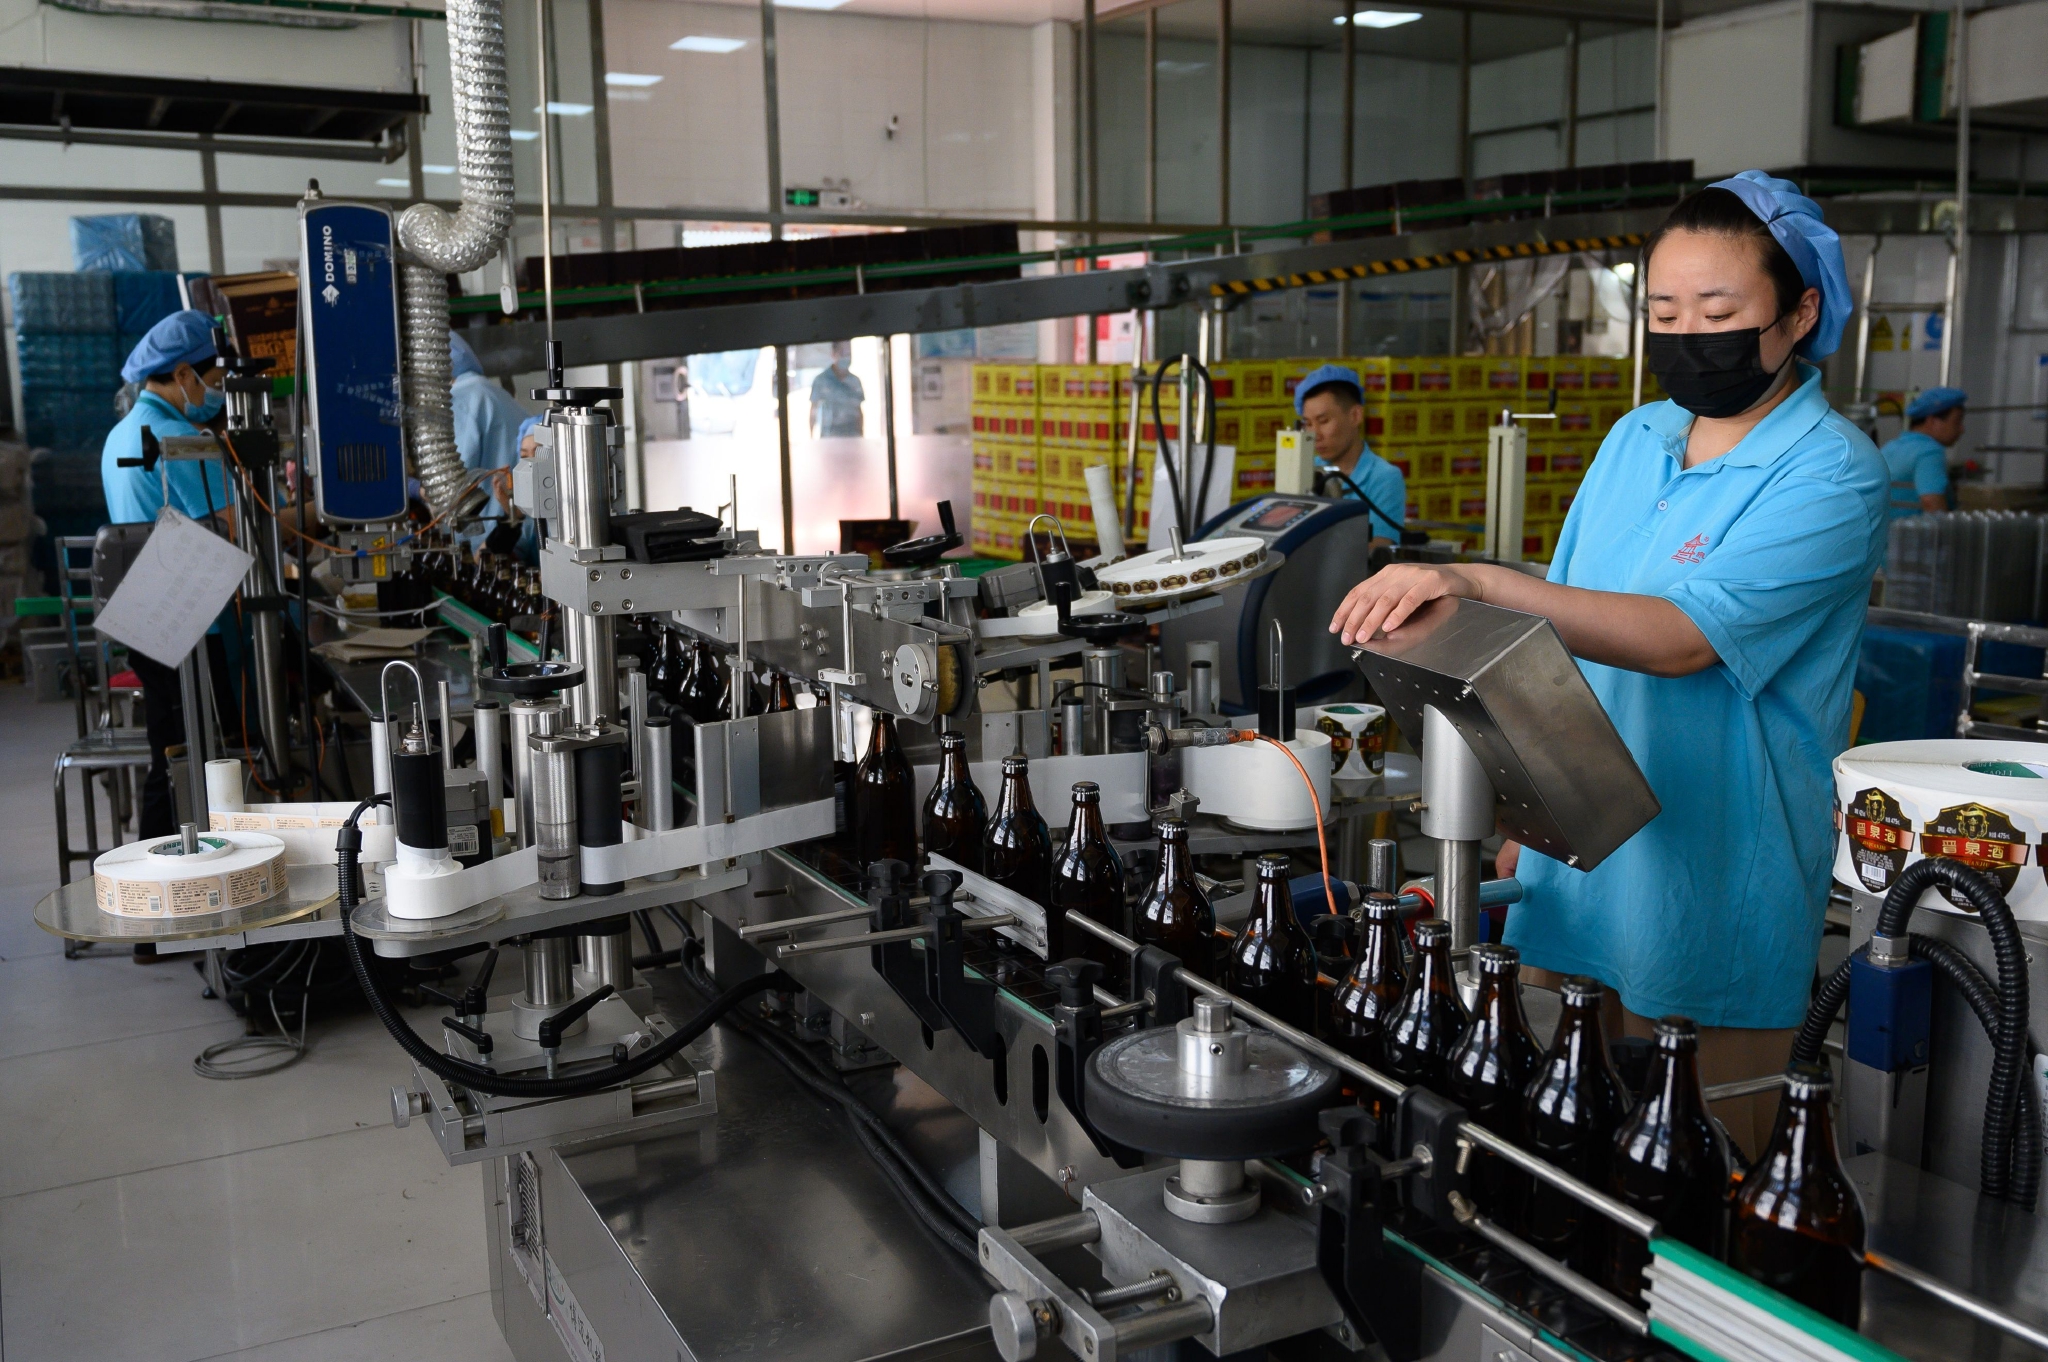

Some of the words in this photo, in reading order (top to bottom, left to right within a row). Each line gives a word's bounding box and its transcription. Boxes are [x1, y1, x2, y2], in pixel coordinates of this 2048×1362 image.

[322, 225, 335, 282] DOMINO
[1856, 821, 1897, 844] 晋泉酒
[1941, 840, 2004, 859] 晋泉酒
